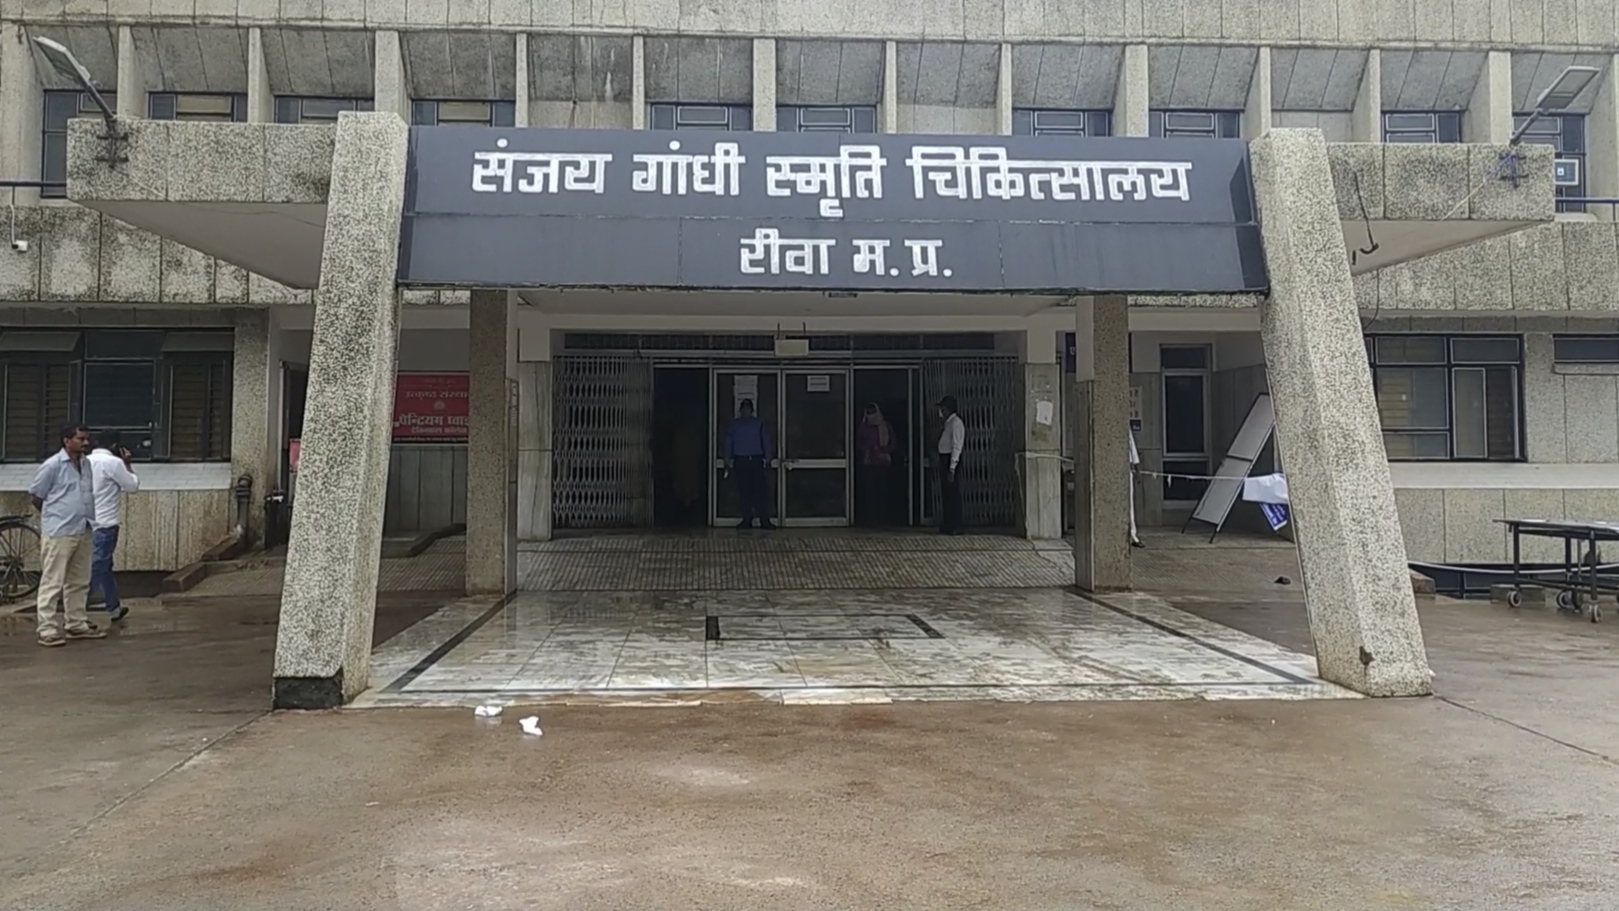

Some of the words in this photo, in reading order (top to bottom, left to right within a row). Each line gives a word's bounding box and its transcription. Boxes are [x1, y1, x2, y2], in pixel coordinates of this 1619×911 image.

[471, 138, 613, 194] संजय
[632, 140, 746, 196] गांधी
[765, 144, 888, 218] स्मृति
[904, 145, 1193, 201] चिकित्सालय
[740, 227, 836, 275] रीवा
